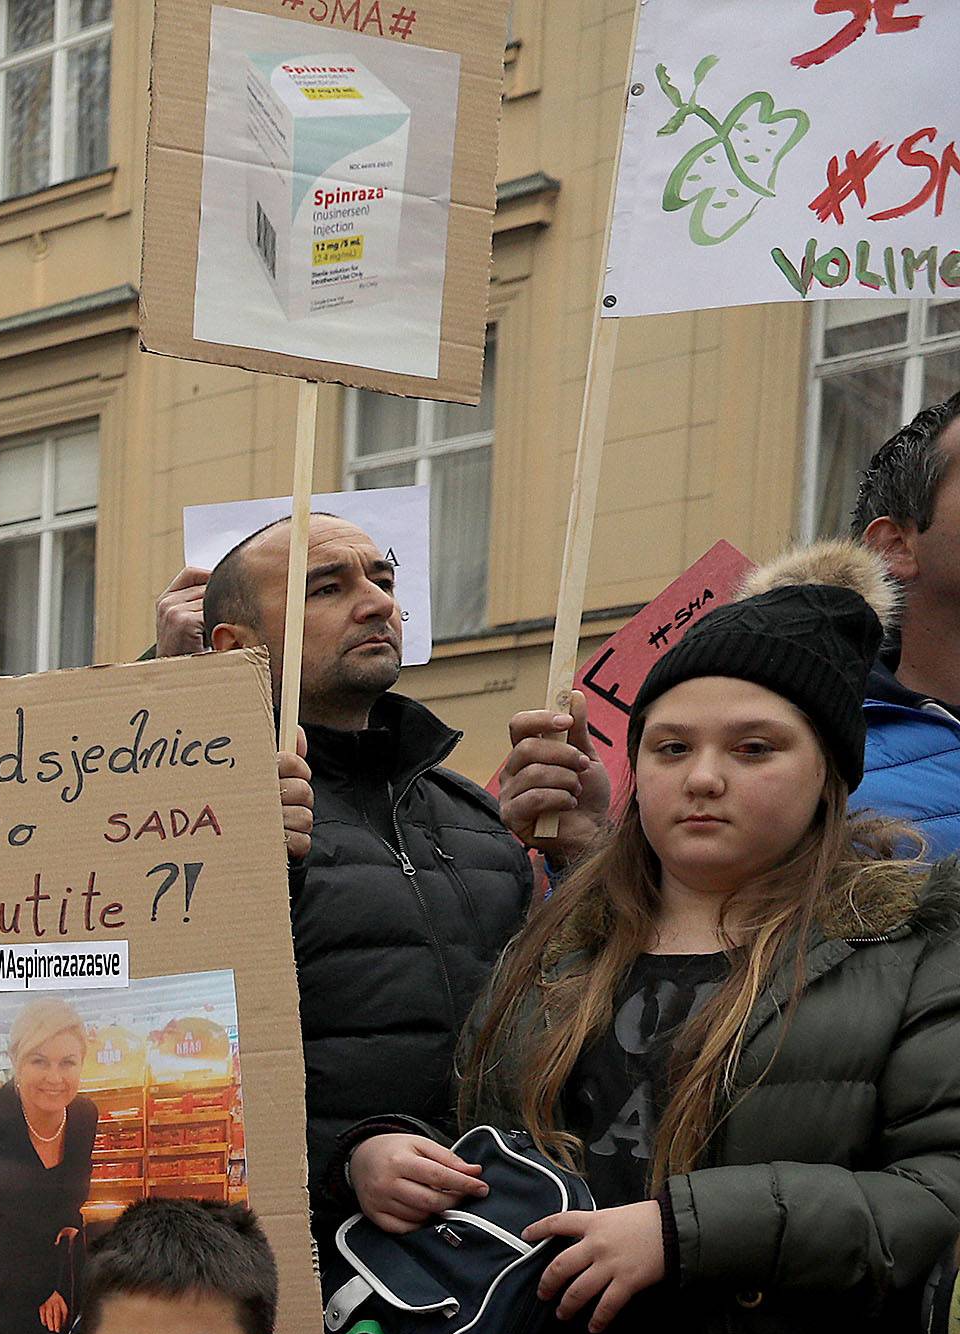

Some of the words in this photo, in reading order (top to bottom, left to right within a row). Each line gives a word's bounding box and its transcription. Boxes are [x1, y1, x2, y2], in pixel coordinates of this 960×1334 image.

[314, 187, 385, 209] Spinraza
[313, 222, 354, 236] Injection
[103, 805, 223, 844] SADA
